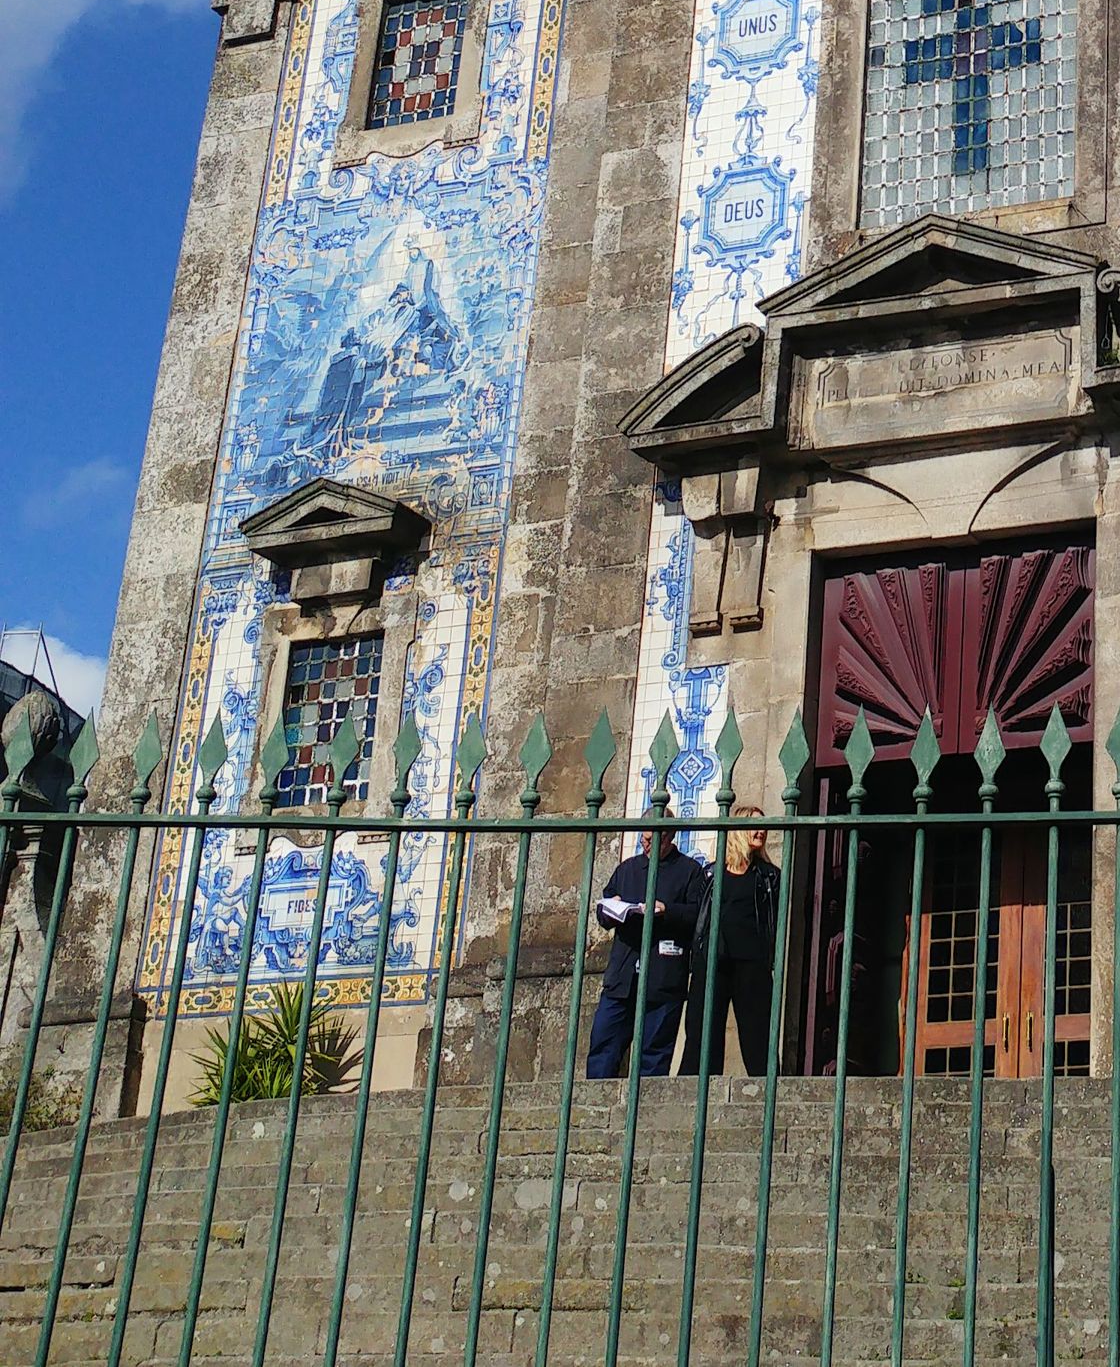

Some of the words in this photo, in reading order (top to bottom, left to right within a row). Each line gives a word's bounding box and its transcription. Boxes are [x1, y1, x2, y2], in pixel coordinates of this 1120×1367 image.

[738, 13, 778, 38] UNUS
[723, 198, 765, 224] DEUS
[287, 898, 318, 914] FIDES
